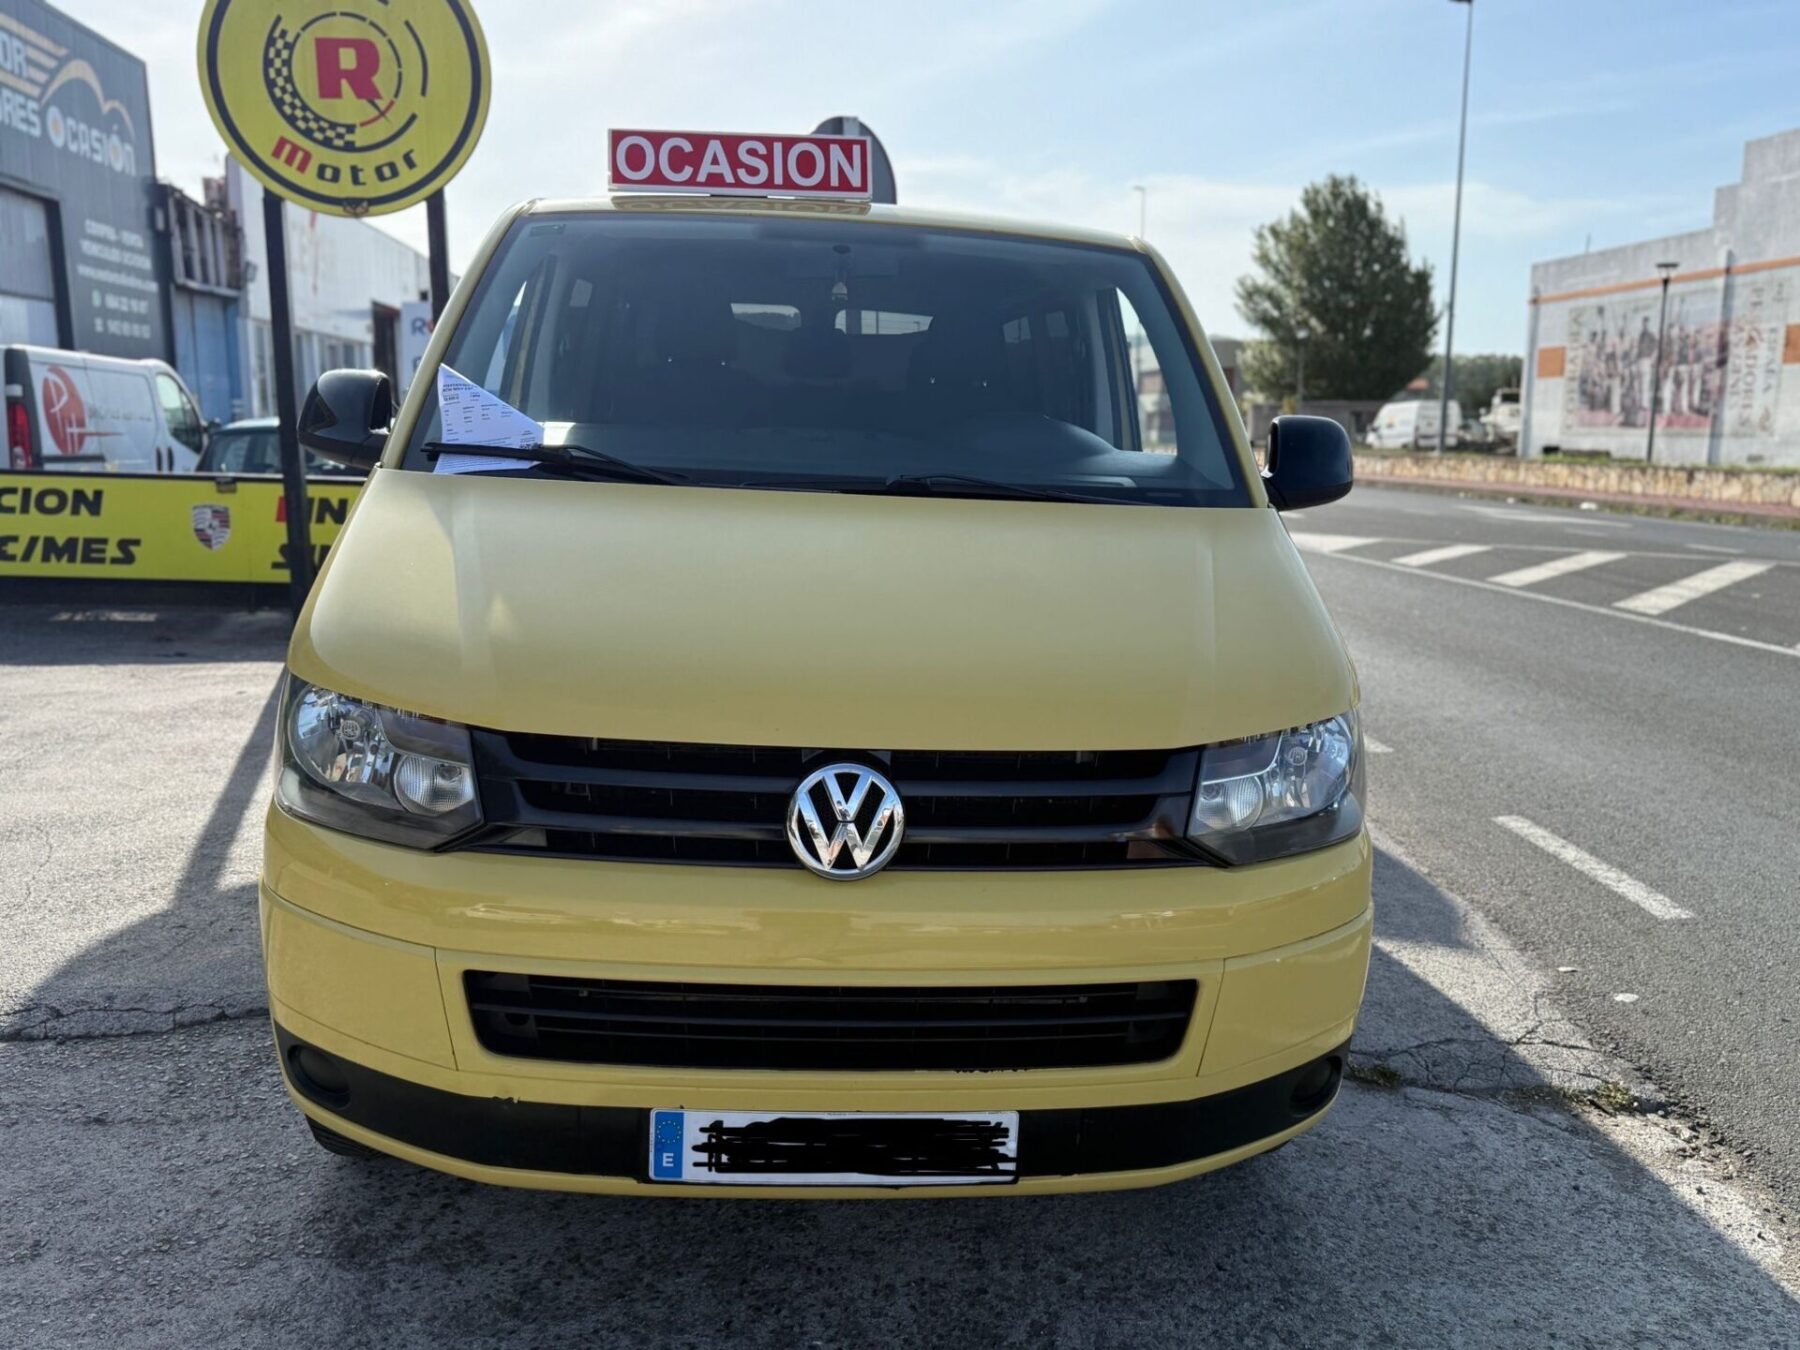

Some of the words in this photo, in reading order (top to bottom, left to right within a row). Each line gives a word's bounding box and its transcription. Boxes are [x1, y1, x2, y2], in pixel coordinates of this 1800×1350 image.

[314, 37, 383, 99] R
[616, 135, 862, 188] OCASION
[662, 1152, 674, 1167] E
